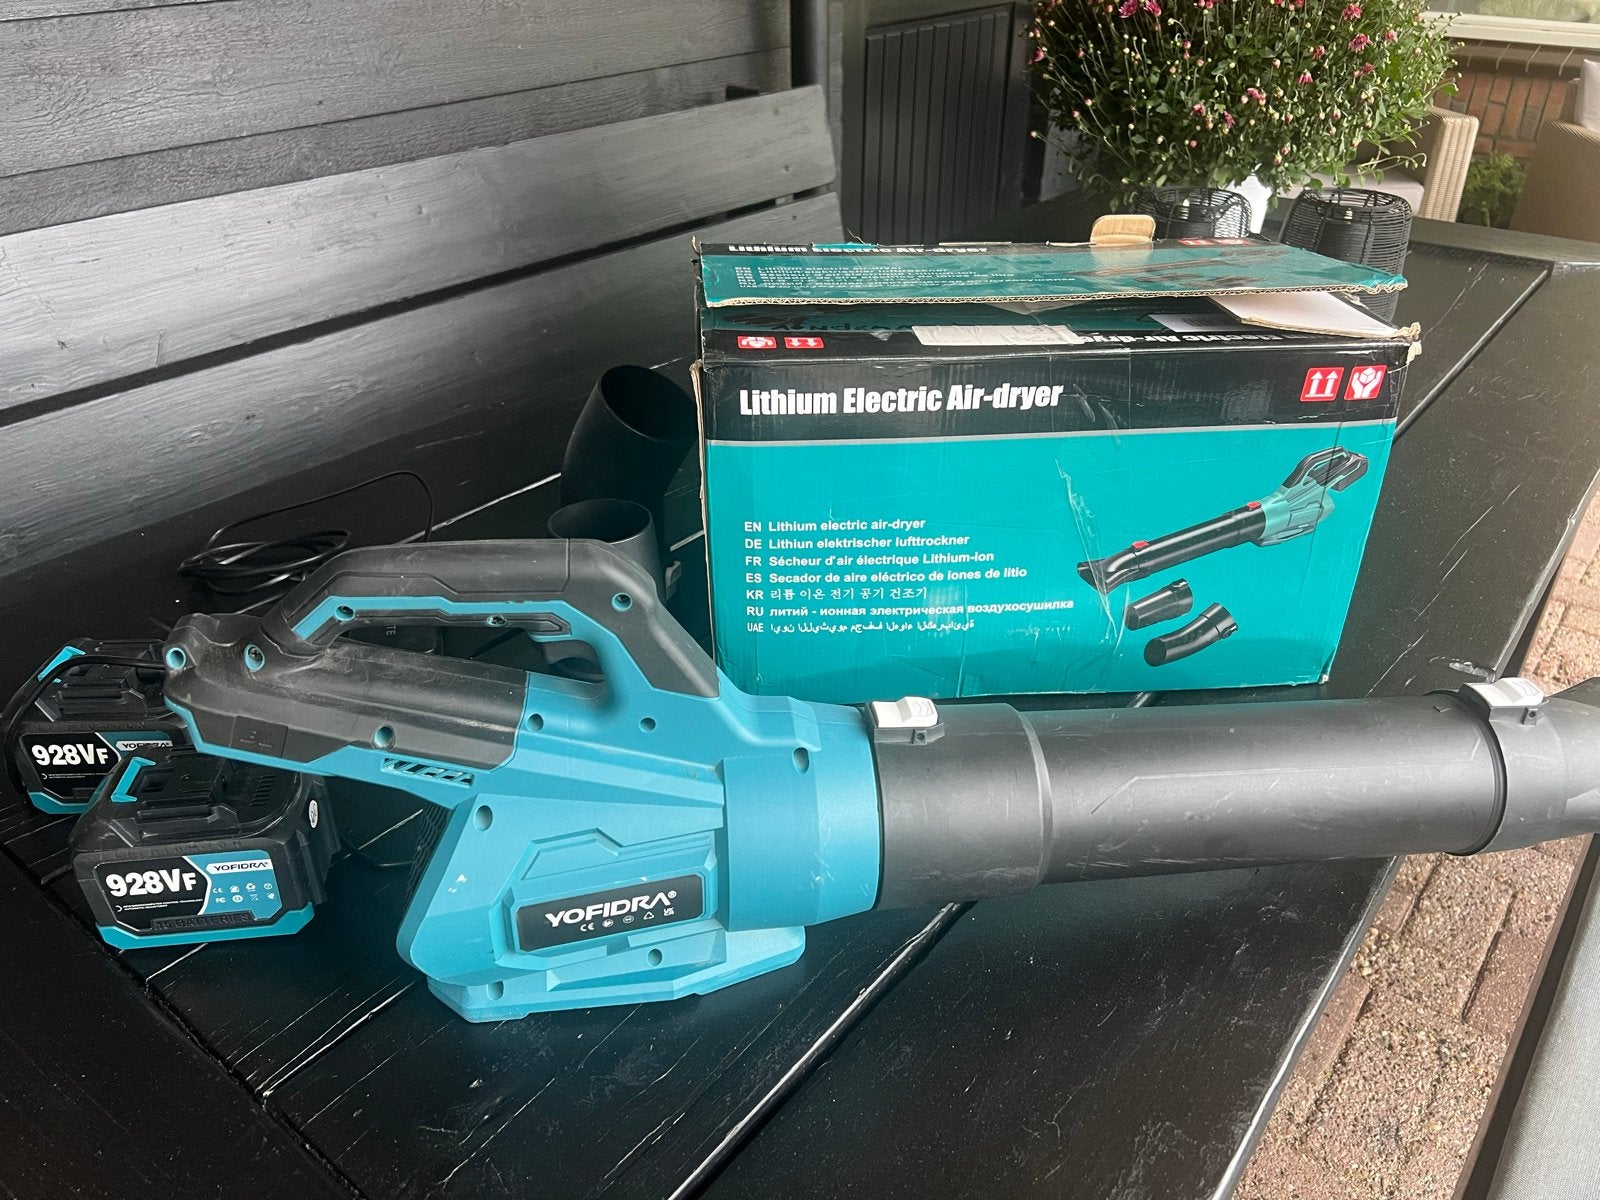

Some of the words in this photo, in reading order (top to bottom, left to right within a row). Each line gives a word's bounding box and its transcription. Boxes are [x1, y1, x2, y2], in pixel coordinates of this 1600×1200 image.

[740, 389, 837, 415] Lithium
[843, 386, 942, 413] Electric
[946, 383, 1064, 410] Air-dryer
[745, 522, 761, 531] EN
[769, 522, 816, 531] Lithium
[821, 520, 867, 530] electric
[871, 519, 925, 531] air-dryer
[745, 539, 761, 549] DE
[769, 539, 813, 549] Lithiun
[817, 538, 892, 548] elektrischer
[896, 535, 969, 546] lufttrockner
[746, 556, 761, 566] FR
[770, 557, 821, 566] Sécheur
[857, 555, 919, 566] électrique
[746, 573, 762, 583] ES
[770, 574, 821, 583] Secador
[825, 573, 840, 582] de
[844, 573, 867, 582] aire
[871, 572, 925, 582] eléctrico
[929, 571, 944, 581] de
[948, 571, 981, 580] iones
[985, 569, 1000, 578] de
[746, 590, 763, 599] KR
[800, 589, 824, 599] 이온
[831, 588, 853, 599] 전기
[861, 588, 883, 599] 공기
[891, 587, 926, 599] 건조기
[747, 607, 763, 616] RU
[770, 607, 808, 616] литий
[870, 606, 964, 618] электрическая
[966, 599, 1074, 613] воздухосушилка
[748, 623, 763, 632] UAE
[32, 743, 109, 766] 928VF
[105, 868, 197, 897] 928VF
